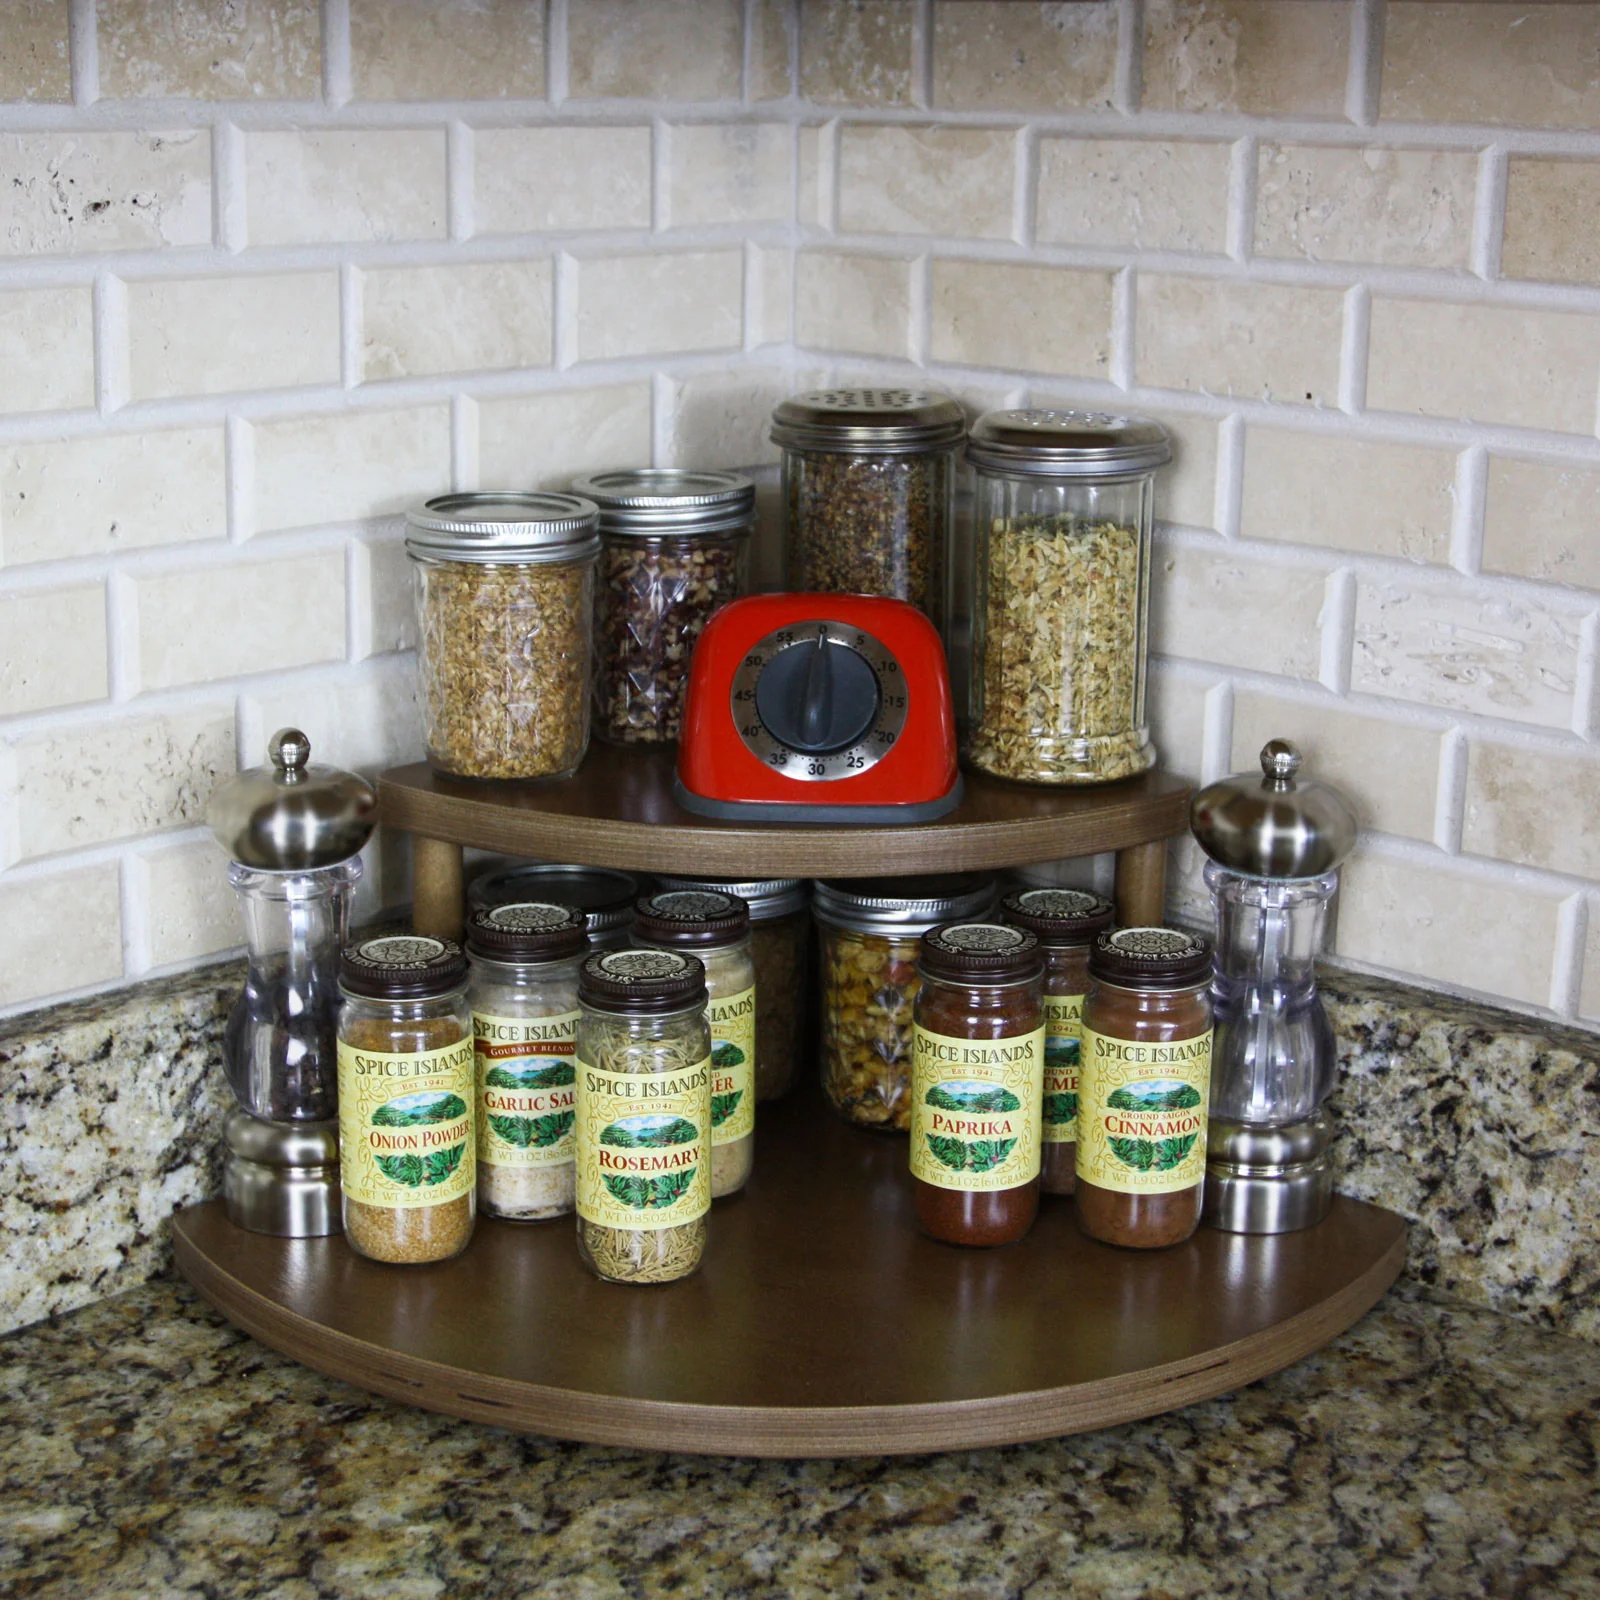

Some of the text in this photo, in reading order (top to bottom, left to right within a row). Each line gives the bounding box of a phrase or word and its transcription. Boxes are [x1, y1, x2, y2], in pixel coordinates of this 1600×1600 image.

[818, 624, 828, 635] 0
[776, 631, 794, 643] 55
[855, 635, 865, 645] 5
[745, 655, 762, 668] 50
[880, 661, 898, 673] 10
[734, 690, 752, 701] 45
[889, 696, 905, 708] 15
[741, 725, 759, 738] 40
[878, 732, 895, 745] 20
[769, 753, 787, 766] 35
[846, 756, 865, 769] 25
[807, 763, 826, 776] 30
[472, 1016, 520, 1041] SPICE
[490, 1045, 575, 1057] GOURMET BLENDS
[917, 1034, 1034, 1064] SPICE ISLANDS
[1095, 1034, 1211, 1063] SPICE ISLANDS
[354, 1041, 473, 1077] SPICE ISLANDS
[424, 1078, 445, 1088] 1941
[586, 1072, 637, 1098] SPICE
[642, 1066, 707, 1098] ISLANDS
[484, 1091, 575, 1112] GARLIC SAL
[651, 1102, 673, 1110] 1941
[1120, 1109, 1191, 1121] GROUND SAIGON
[932, 1113, 1013, 1135] PAPRIKA
[1104, 1113, 1201, 1137] CINNAMON
[369, 1119, 470, 1149] ONION POWDER
[598, 1146, 701, 1171] ROSEMARY
